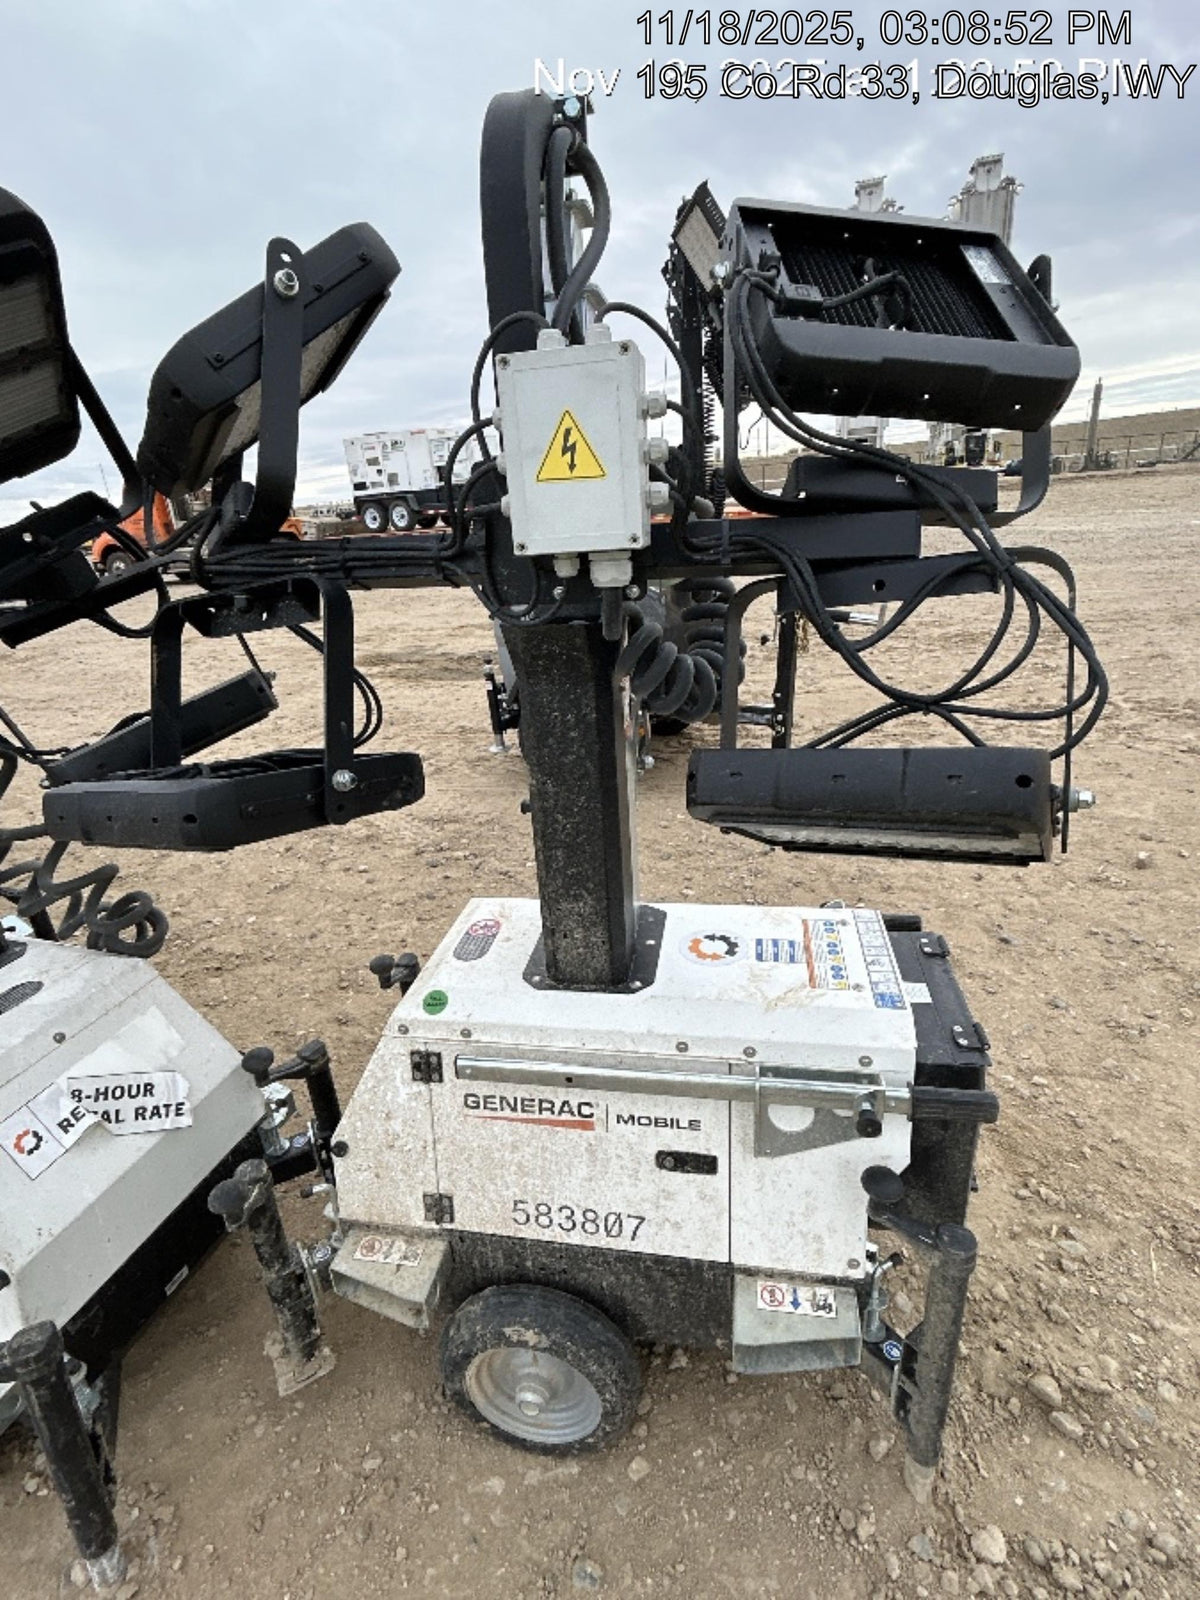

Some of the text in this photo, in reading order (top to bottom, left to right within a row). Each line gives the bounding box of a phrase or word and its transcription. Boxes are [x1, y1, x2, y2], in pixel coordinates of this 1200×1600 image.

[134, 1101, 186, 1121] RATE
[463, 1092, 702, 1131] GENERAC MOBILE
[511, 1199, 647, 1241] 583807
